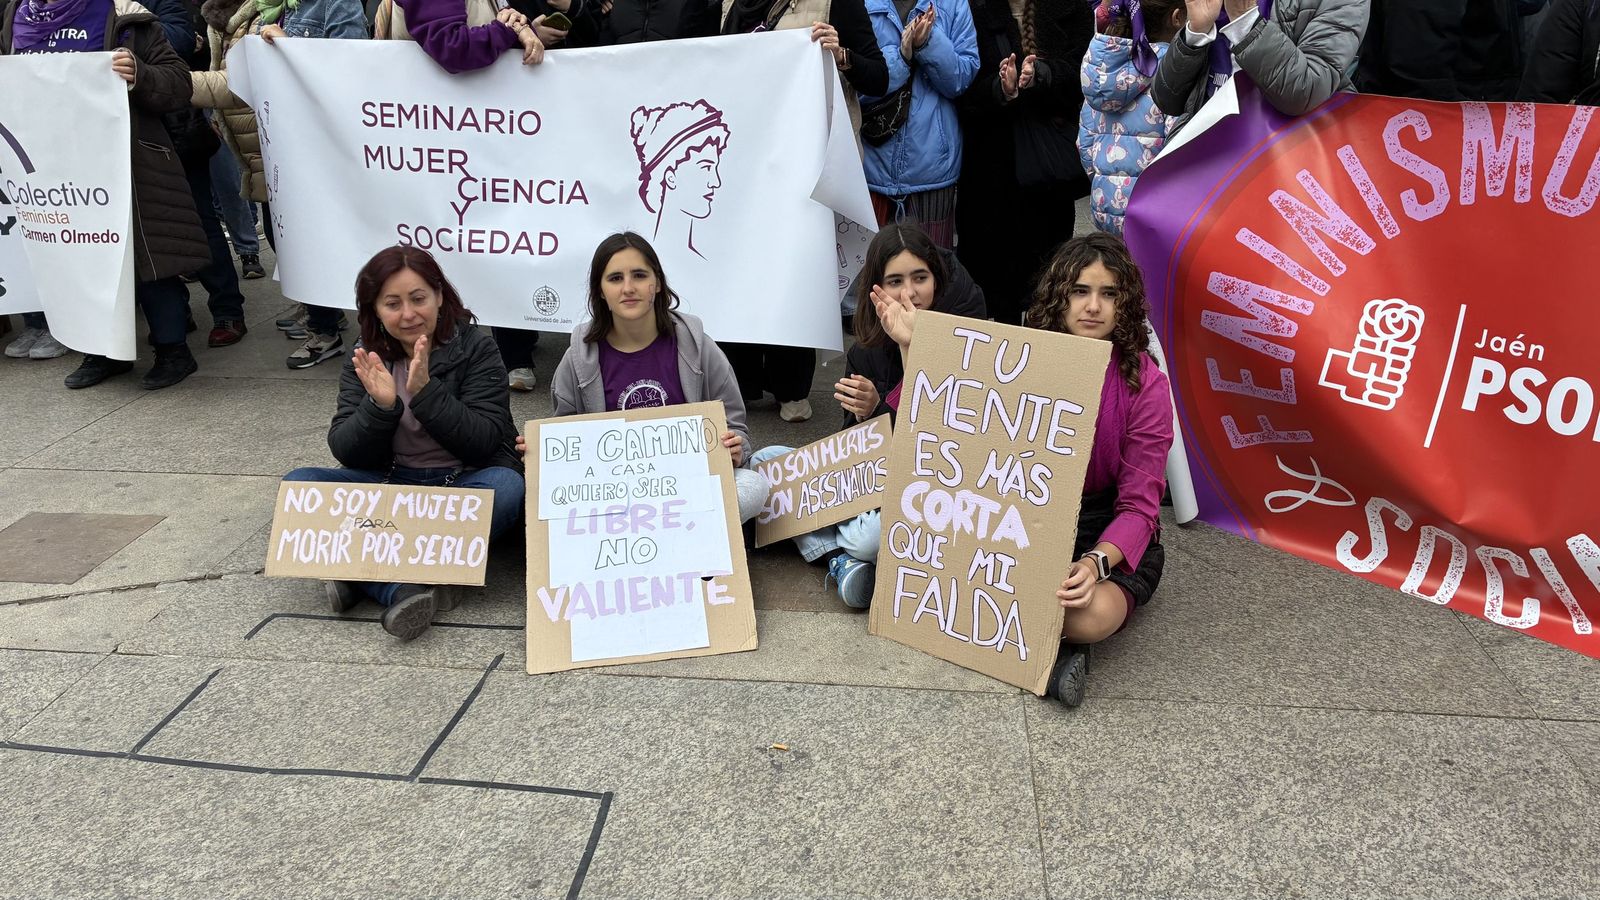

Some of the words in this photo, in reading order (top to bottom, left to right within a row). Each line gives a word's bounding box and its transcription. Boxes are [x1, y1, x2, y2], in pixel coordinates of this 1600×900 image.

[49, 28, 88, 40] NTRA
[363, 144, 473, 178] MUJER
[7, 179, 109, 207] Colectivo
[15, 206, 70, 225] Feminista
[450, 200, 472, 226] Y
[21, 225, 57, 243] Carmen
[61, 229, 120, 244] Olmedo
[953, 327, 1031, 384] TU
[1474, 329, 1545, 361] Jaén
[910, 369, 1084, 455] MENTE
[1461, 356, 1600, 443] PSO
[545, 436, 581, 462] DE
[597, 417, 719, 462] CAMINO
[758, 461, 782, 488] NO
[784, 445, 819, 482] SON
[820, 421, 884, 467] MUERTES
[584, 466, 595, 478] A
[611, 462, 656, 476] CASA
[914, 431, 964, 488] ES
[976, 449, 1053, 506] MÁS
[284, 487, 323, 513] NO
[329, 488, 382, 517] SOY
[391, 492, 482, 522] MUJER
[551, 481, 629, 506] QUIERO
[632, 476, 678, 498] SER
[758, 487, 793, 524] SON
[797, 457, 888, 520] ASESINATOS
[353, 517, 398, 530] PARA
[566, 499, 696, 536] LIBRE,
[901, 481, 1030, 549] CORTA
[276, 528, 351, 566] MORIR
[361, 531, 404, 567] POR
[408, 534, 486, 568] SERLO
[595, 536, 658, 570] NO
[888, 521, 948, 570] QUE
[967, 548, 1017, 594] MI
[536, 569, 736, 622] VALIENTE
[893, 565, 1028, 661] FALDA
